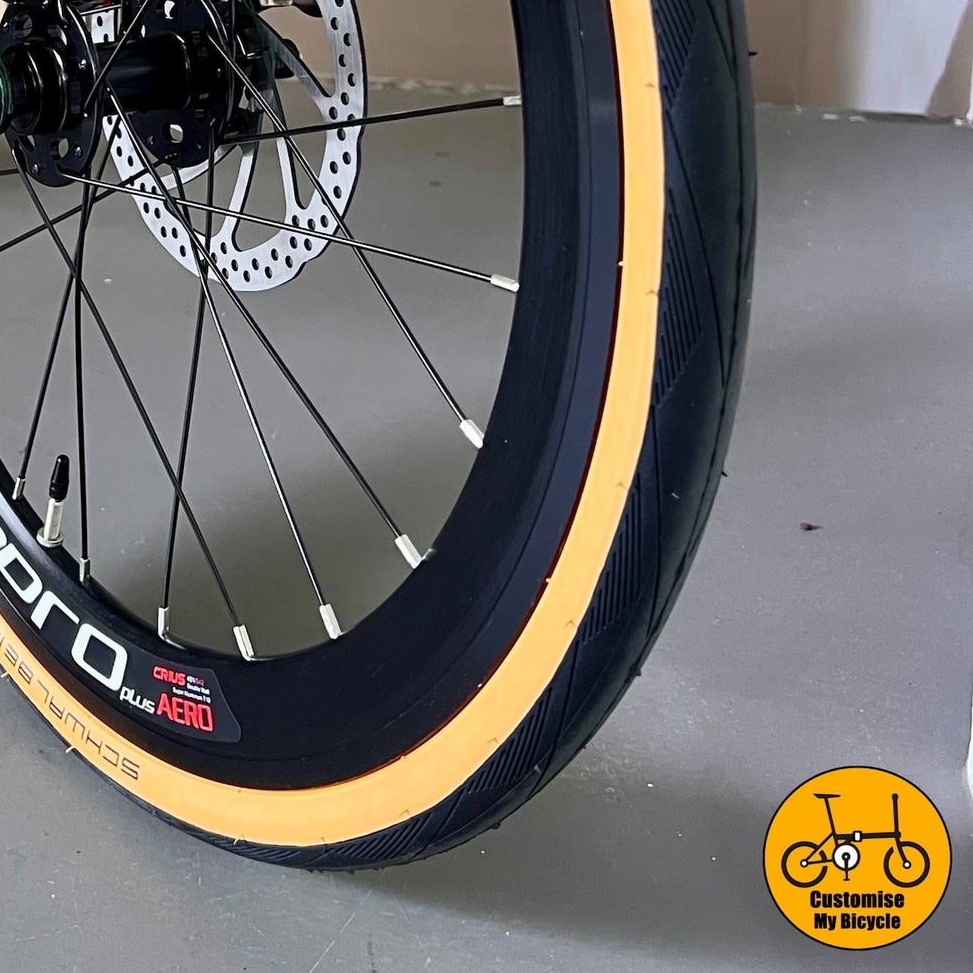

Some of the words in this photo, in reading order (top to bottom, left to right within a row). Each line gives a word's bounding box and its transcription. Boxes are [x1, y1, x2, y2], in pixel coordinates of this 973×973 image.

[153, 666, 186, 686] CRIUS
[4, 647, 141, 782] SCHWALBE
[119, 685, 155, 715] plus
[156, 693, 213, 732] AERO
